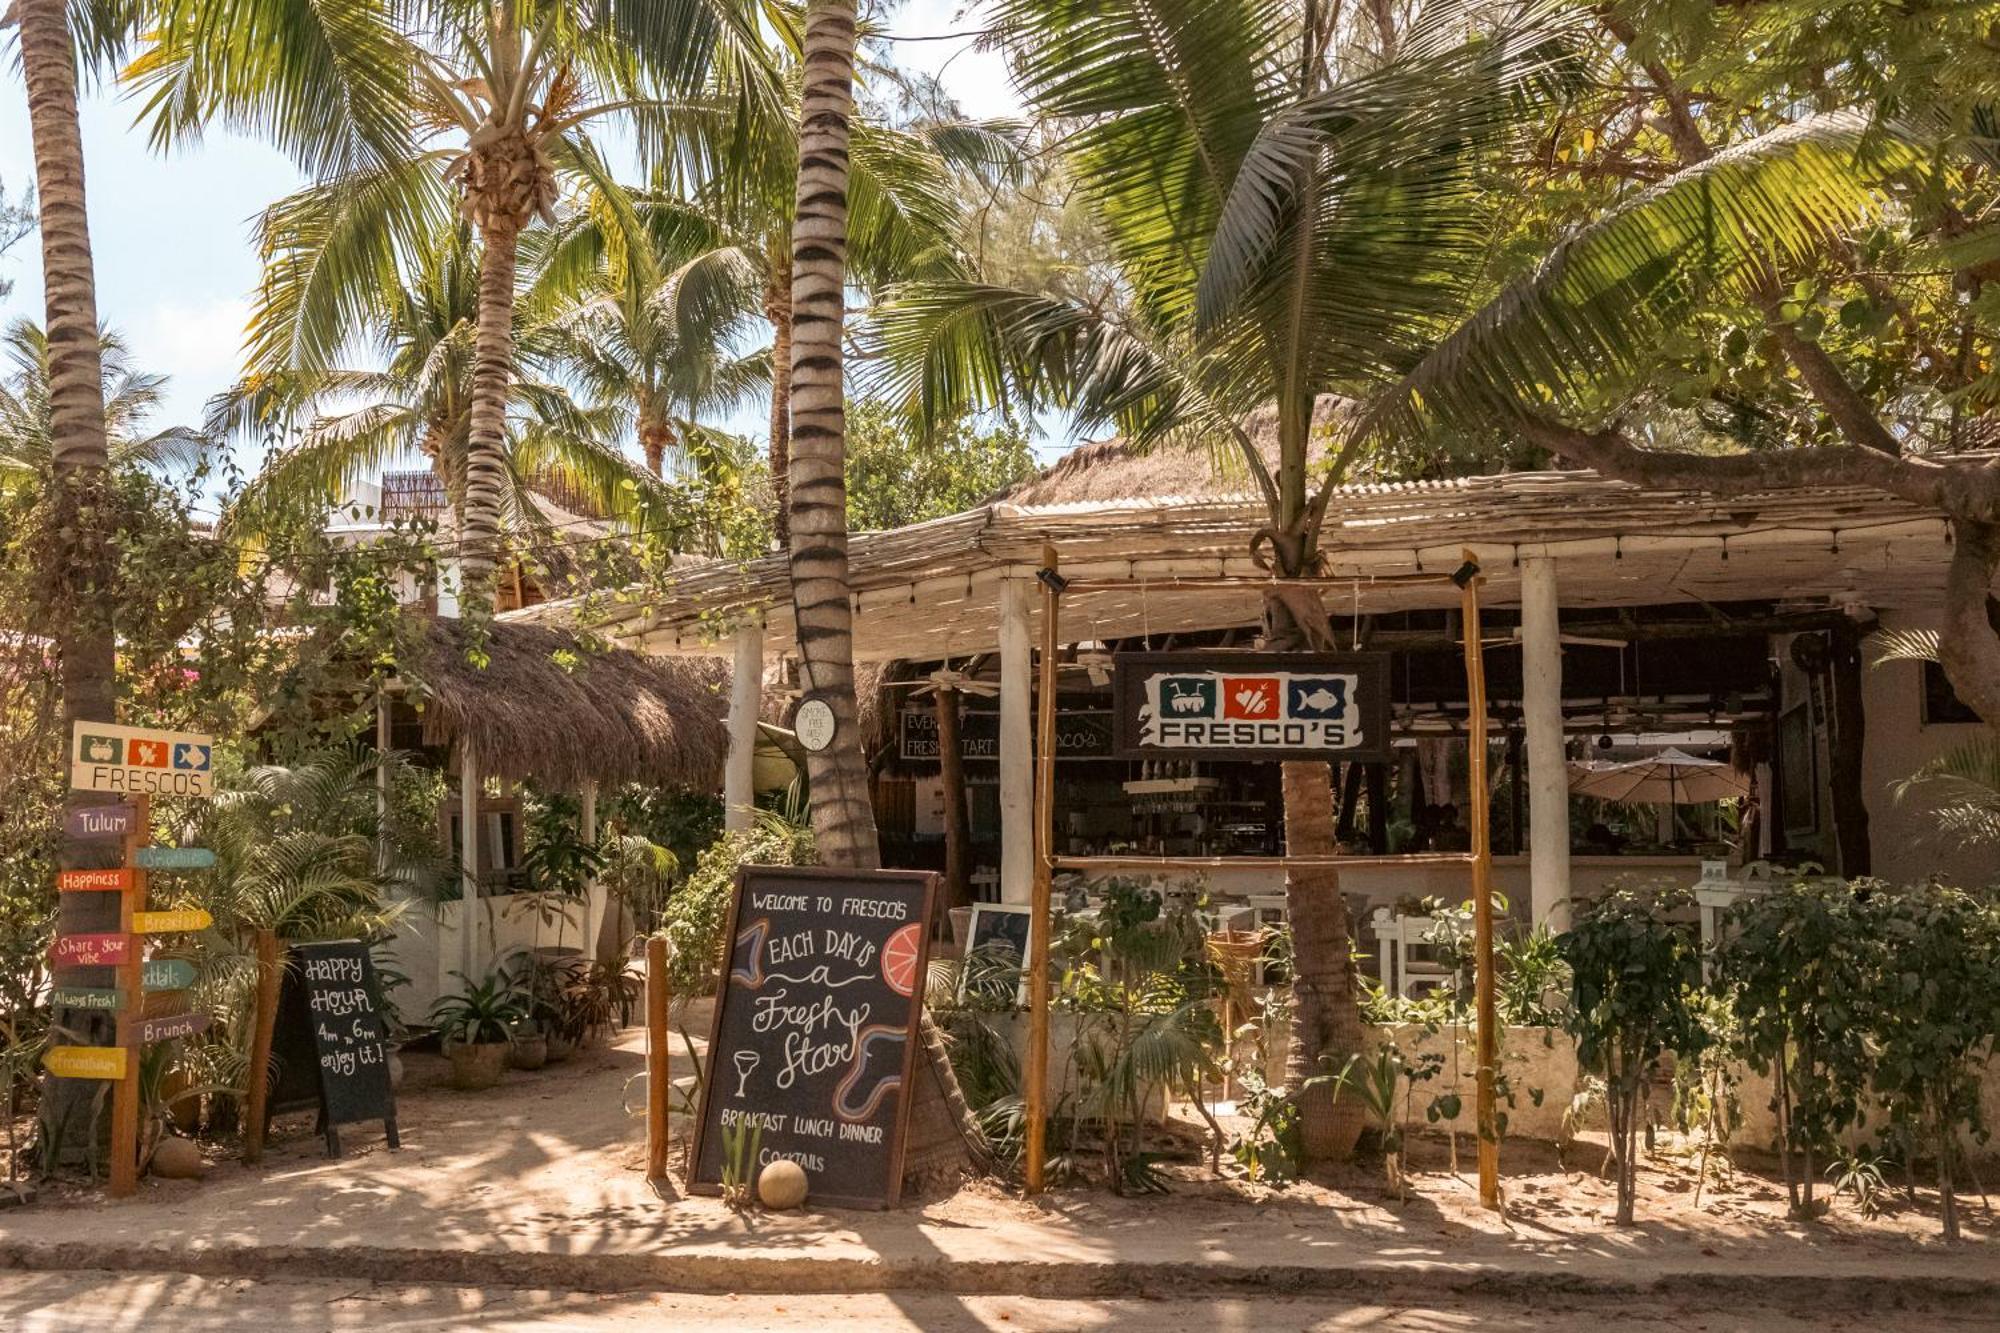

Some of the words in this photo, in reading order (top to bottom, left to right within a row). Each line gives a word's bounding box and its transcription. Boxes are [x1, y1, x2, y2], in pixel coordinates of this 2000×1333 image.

[1159, 722, 1345, 745] FRESCO'S
[961, 739, 995, 755] TART
[92, 766, 202, 797] FRESCO'S
[79, 813, 126, 833] Tulum
[62, 874, 120, 890] Happiness
[752, 892, 809, 912] WELCOME
[817, 896, 832, 913] TO
[841, 898, 908, 920] FRESCO'S
[58, 938, 93, 955] Share
[768, 930, 814, 965] EACH
[825, 929, 862, 961] DAY
[855, 940, 876, 967] IS
[53, 991, 86, 1008] Always
[752, 988, 858, 1034] Fresh
[144, 1021, 193, 1042] Brunch
[777, 1012, 859, 1089] Start
[320, 1050, 356, 1076] enjoy
[794, 1116, 835, 1138] LUNCH
[839, 1122, 883, 1145] DINNER
